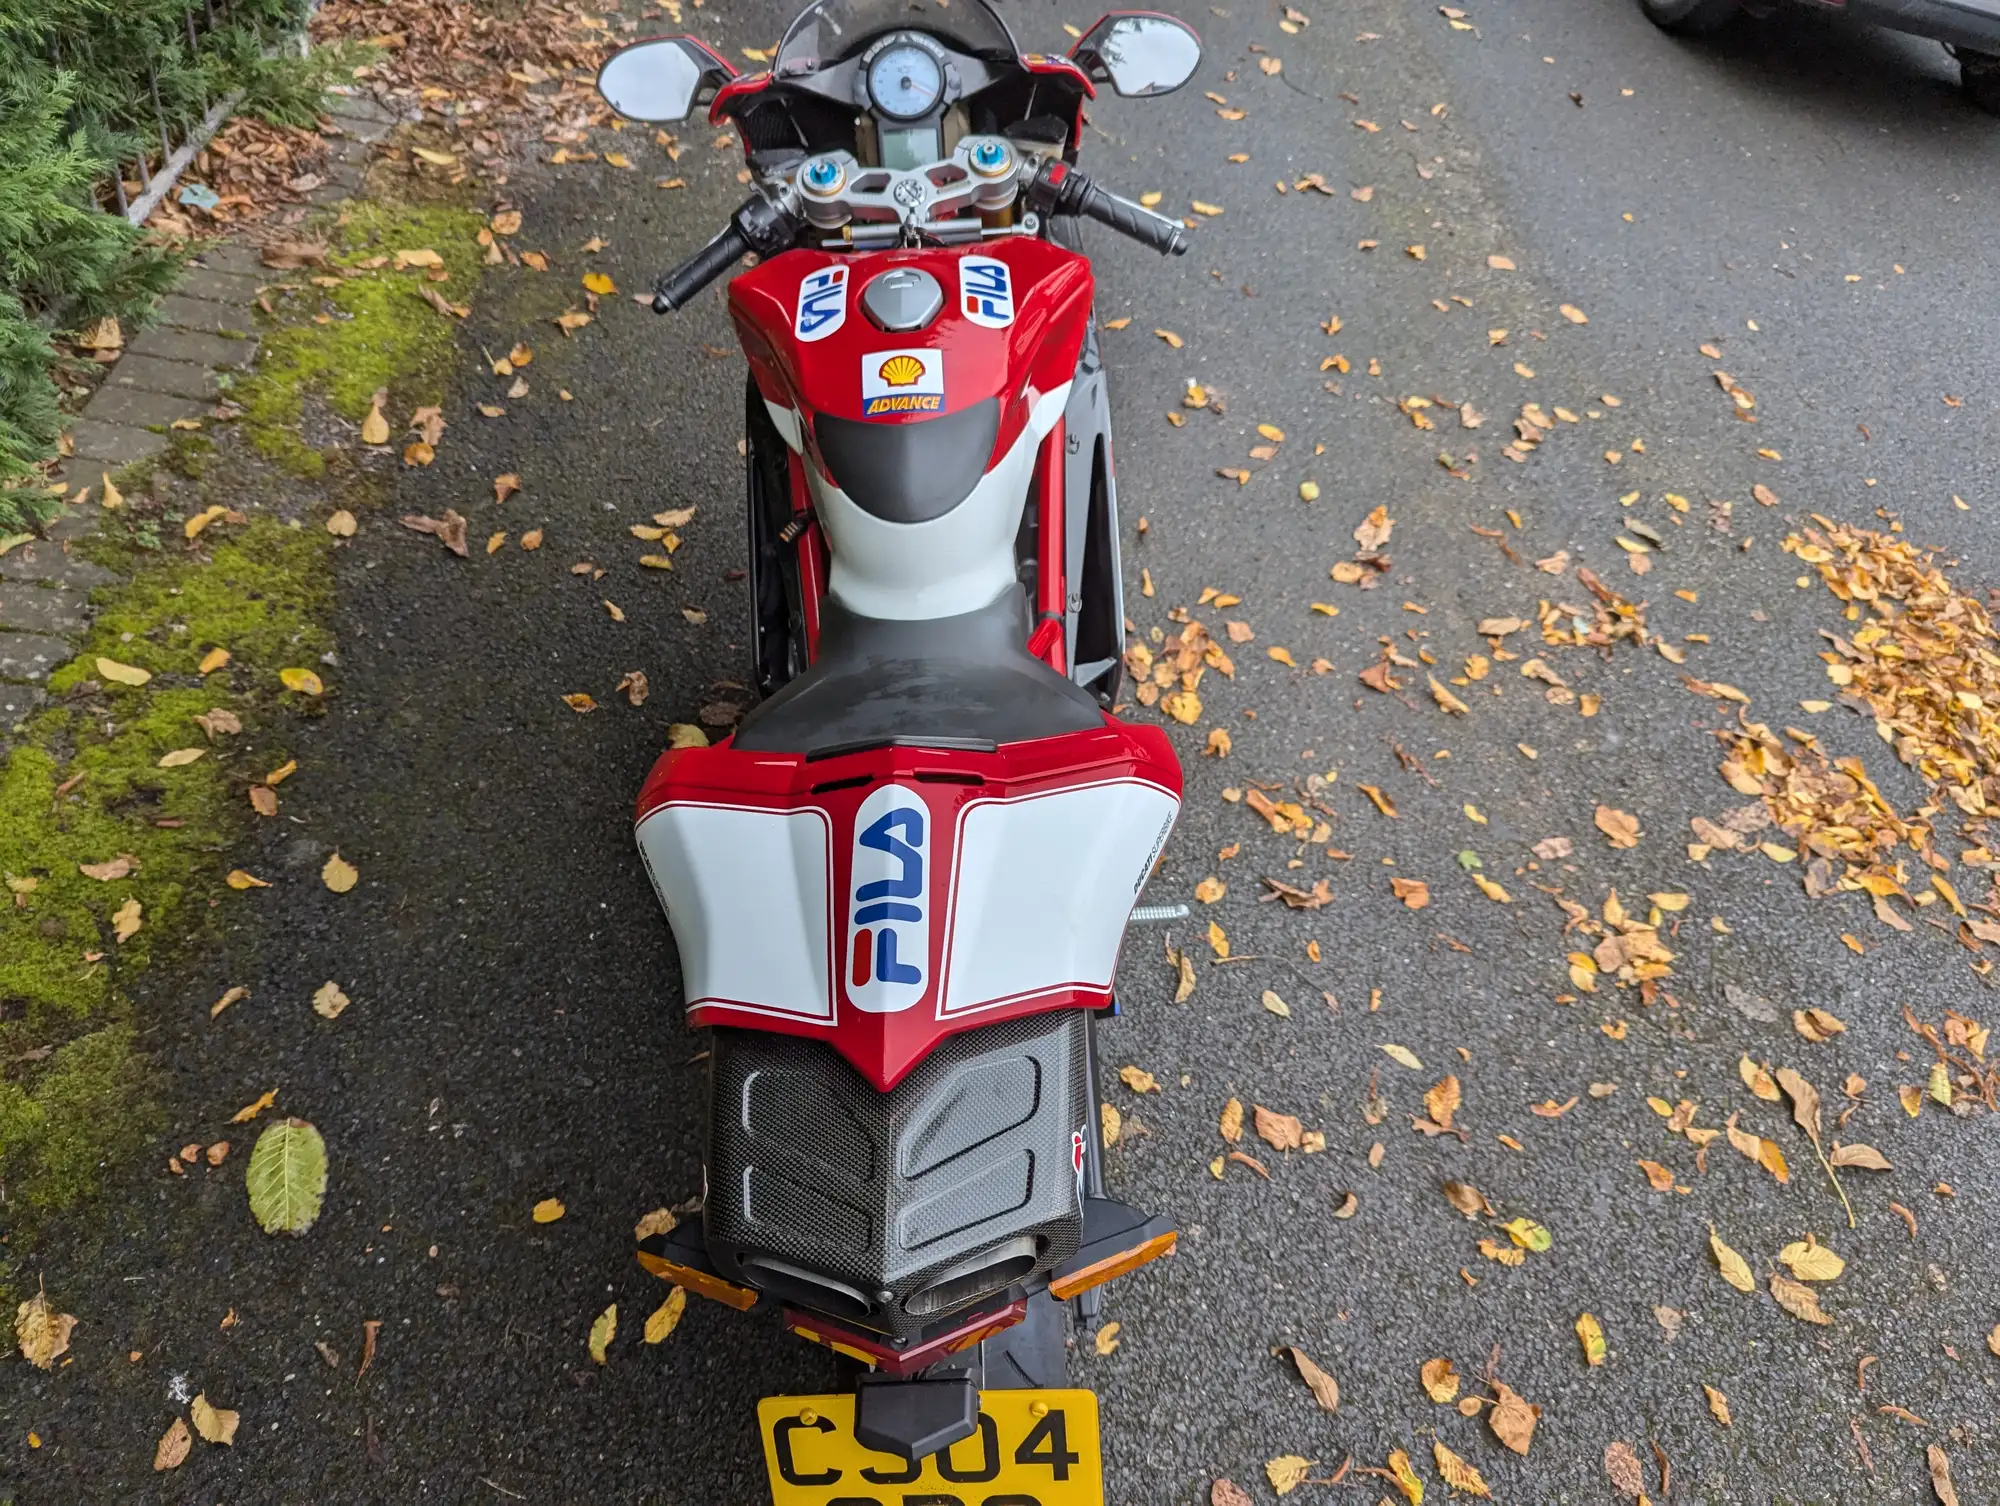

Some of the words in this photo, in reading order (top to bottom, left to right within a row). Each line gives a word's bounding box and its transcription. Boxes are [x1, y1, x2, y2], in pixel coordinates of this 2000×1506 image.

[800, 270, 845, 333] FILA
[964, 264, 1010, 320] FILA
[866, 395, 942, 415] ADVANCE
[852, 807, 924, 987] FILA
[1133, 853, 1153, 895] DUCATI
